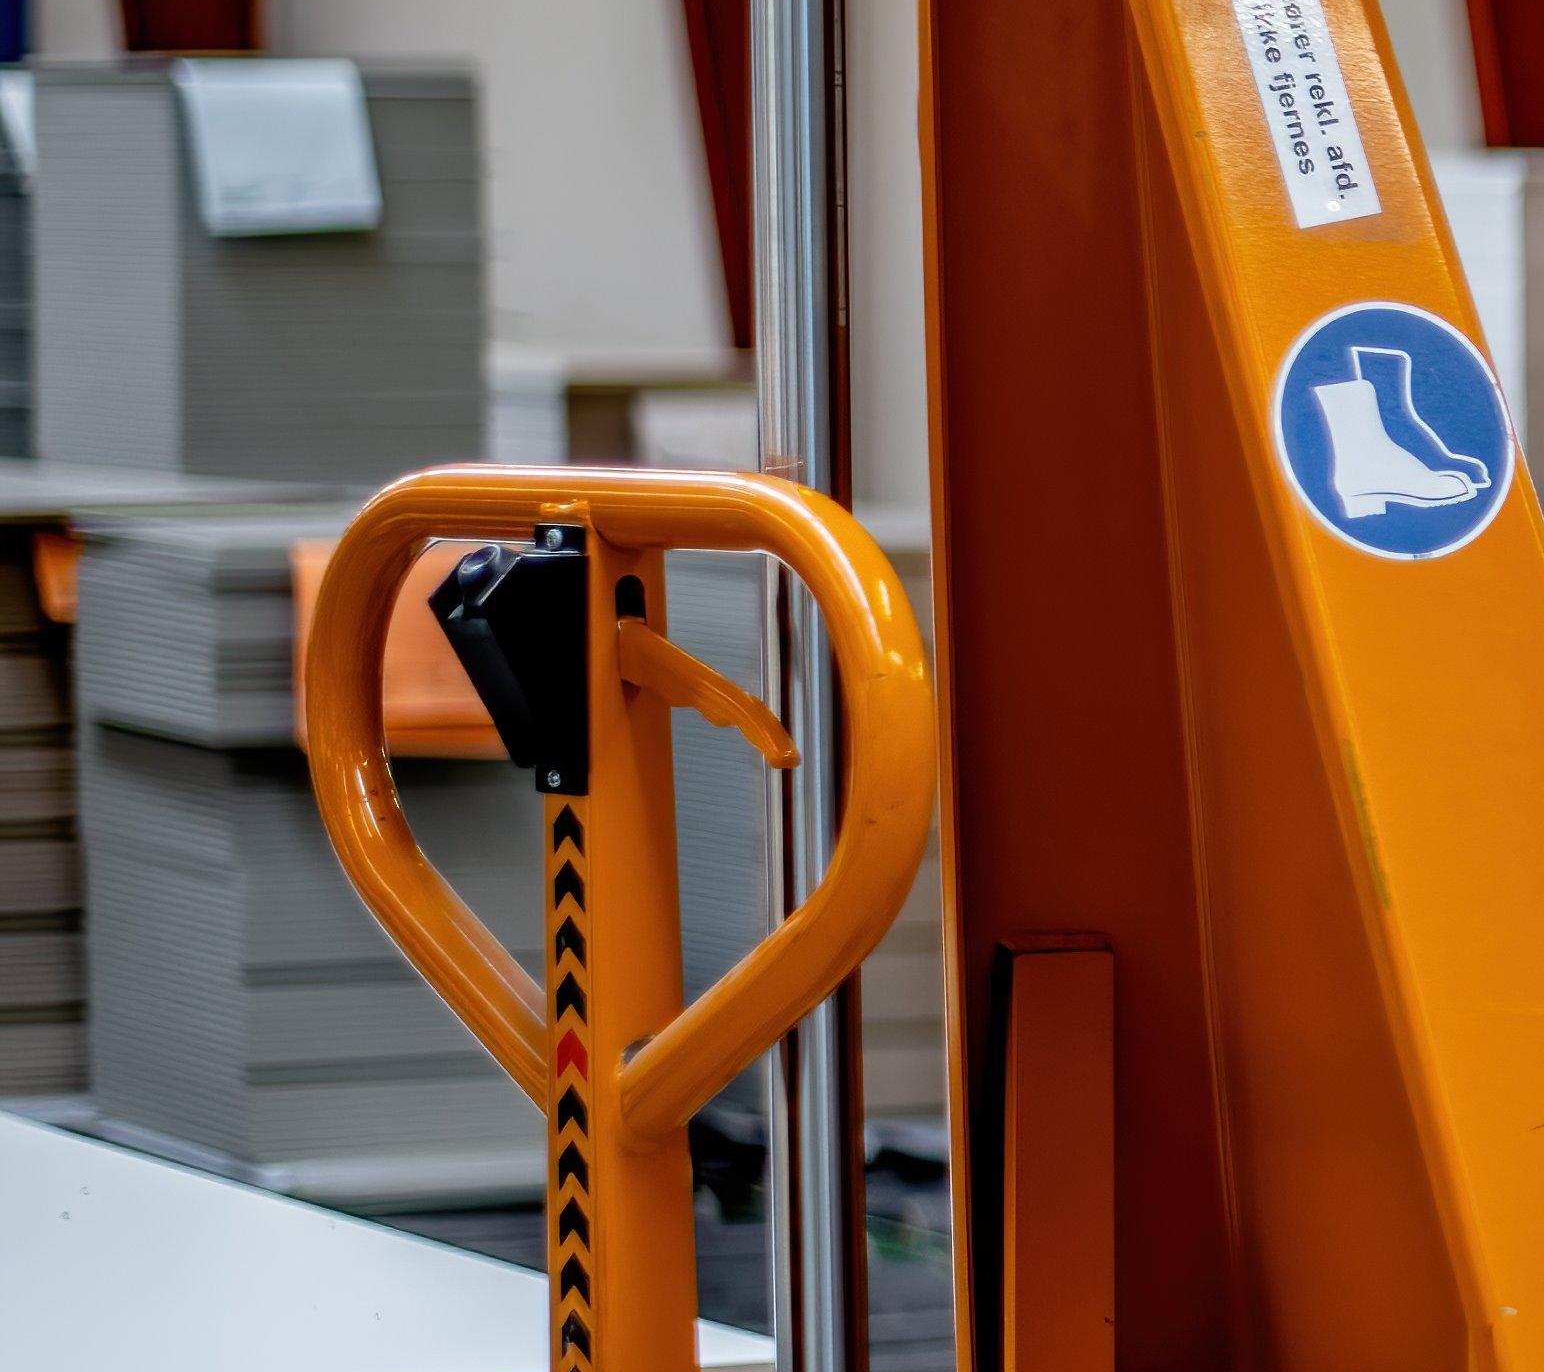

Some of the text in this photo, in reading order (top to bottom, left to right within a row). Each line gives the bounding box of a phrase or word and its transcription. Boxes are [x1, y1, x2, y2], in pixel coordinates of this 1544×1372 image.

[1270, 72, 1315, 176] fjernes
[1306, 73, 1339, 136] rekl.
[1327, 146, 1358, 200] afd.
